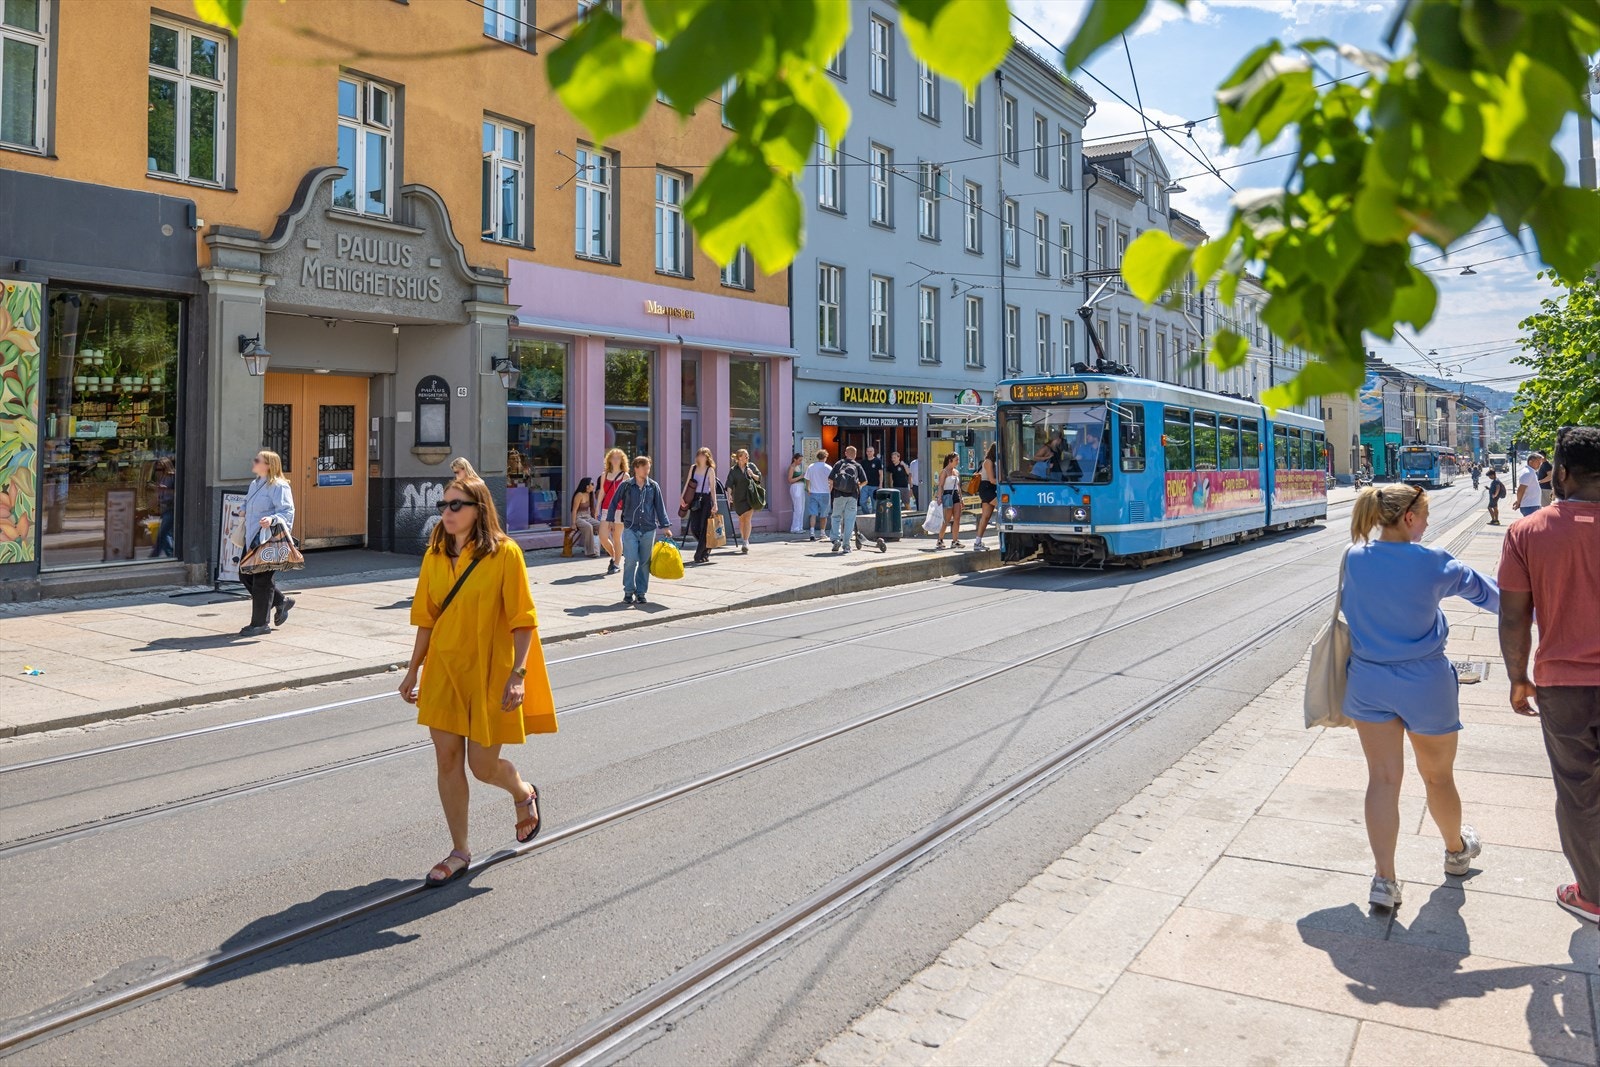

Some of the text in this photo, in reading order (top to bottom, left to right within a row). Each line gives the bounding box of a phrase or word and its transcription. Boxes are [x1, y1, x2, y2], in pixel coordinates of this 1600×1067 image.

[337, 233, 413, 268] PAULUS
[844, 387, 933, 404] PALAZZO PIZZERIA
[1013, 386, 1024, 398] 12
[859, 418, 880, 426] PALAZZO
[881, 418, 898, 426] PIZZERIA
[1037, 492, 1055, 504] 116
